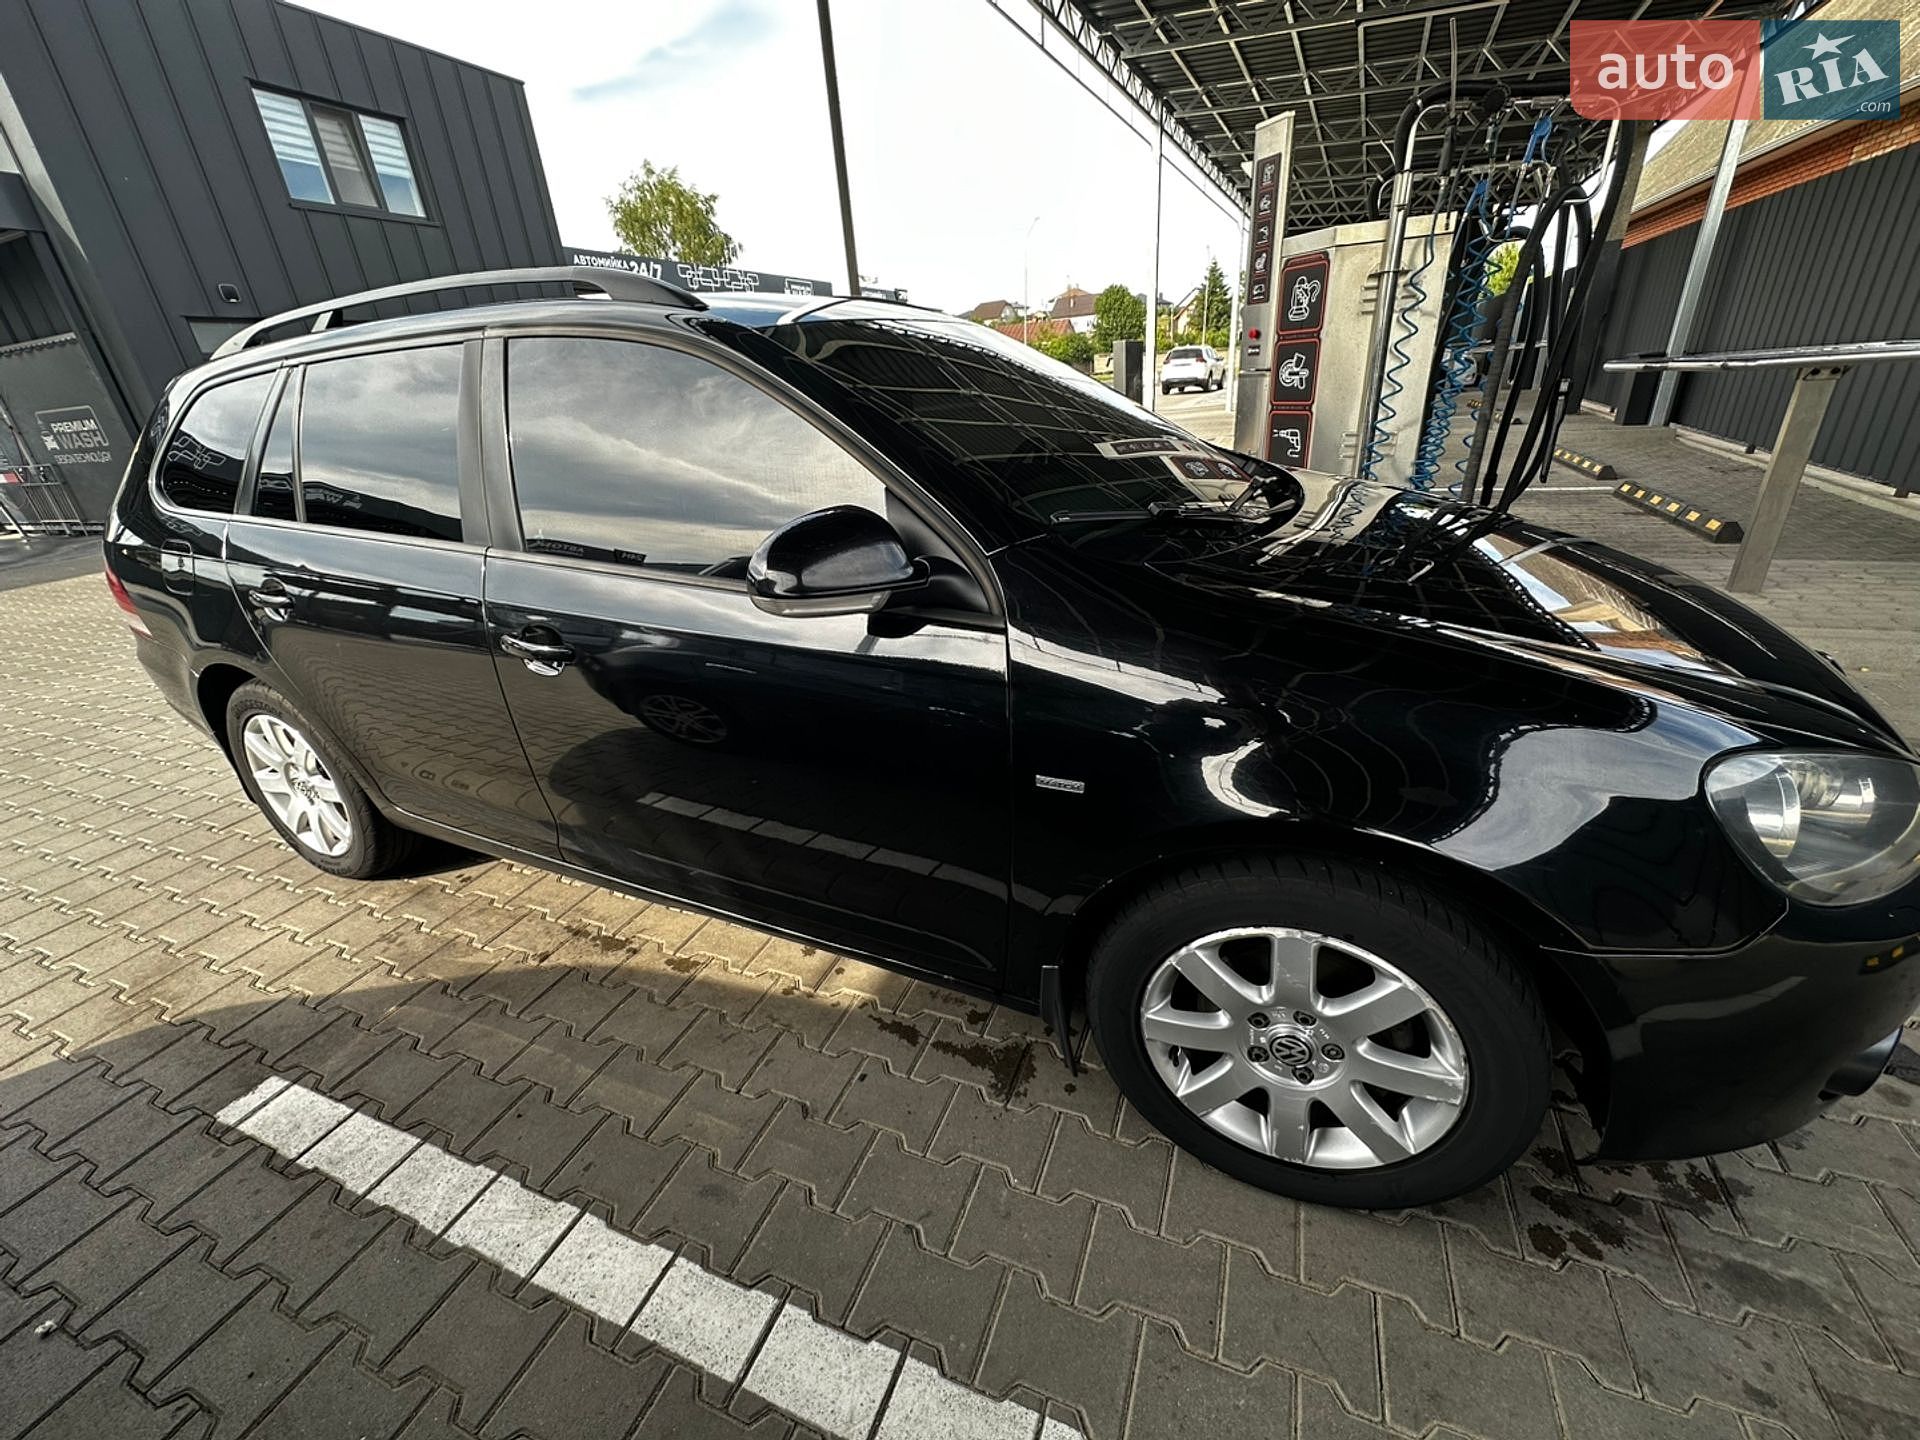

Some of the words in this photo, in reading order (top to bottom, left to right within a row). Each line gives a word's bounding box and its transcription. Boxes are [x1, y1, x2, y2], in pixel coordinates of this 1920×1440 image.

[573, 254, 629, 269] АВТОМИЙКА
[51, 419, 98, 432] PREMIUM
[57, 431, 105, 449] WASH
